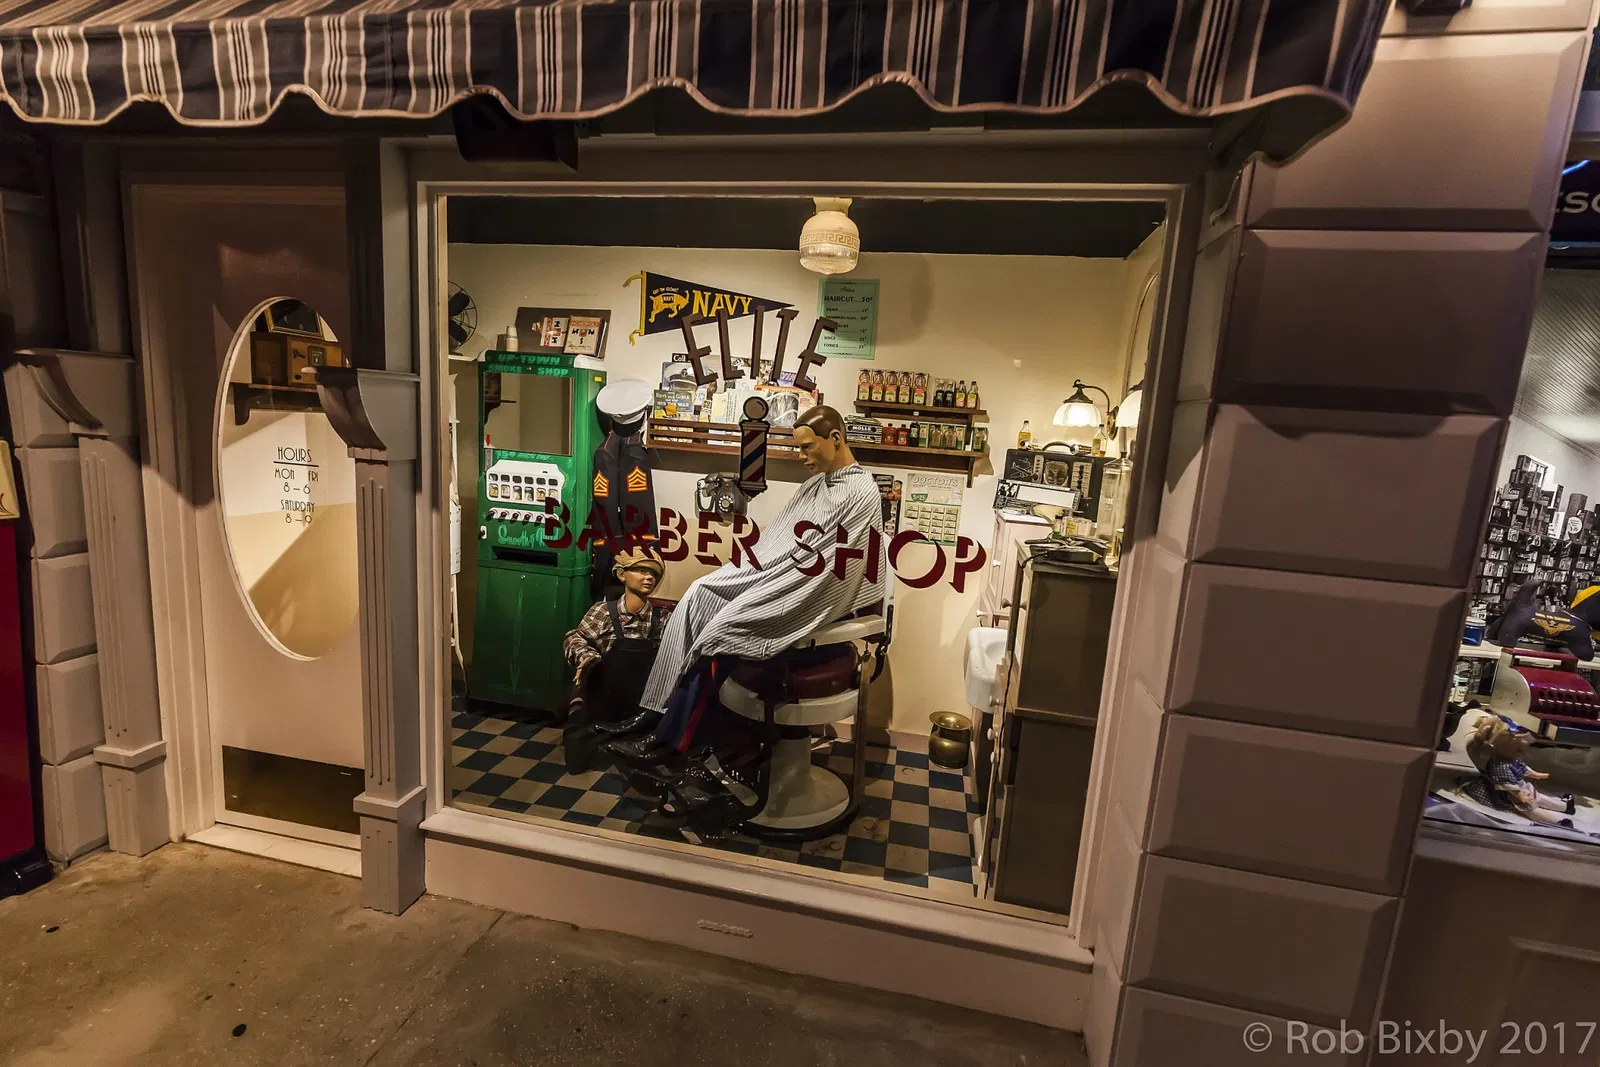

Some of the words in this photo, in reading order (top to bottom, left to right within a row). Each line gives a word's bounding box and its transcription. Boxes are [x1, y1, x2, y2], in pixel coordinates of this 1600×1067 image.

[691, 289, 753, 318] NAVY
[824, 295, 855, 303] HAIRCUT
[681, 305, 838, 392] ELITE
[488, 363, 523, 373] SMOKE
[537, 367, 569, 377] SHOP
[277, 446, 313, 463] HOURS
[274, 468, 295, 481] MON
[308, 470, 319, 482] FRI
[280, 499, 316, 513] SATURDAY
[542, 496, 764, 572] BARBER
[790, 519, 986, 593] SHOP
